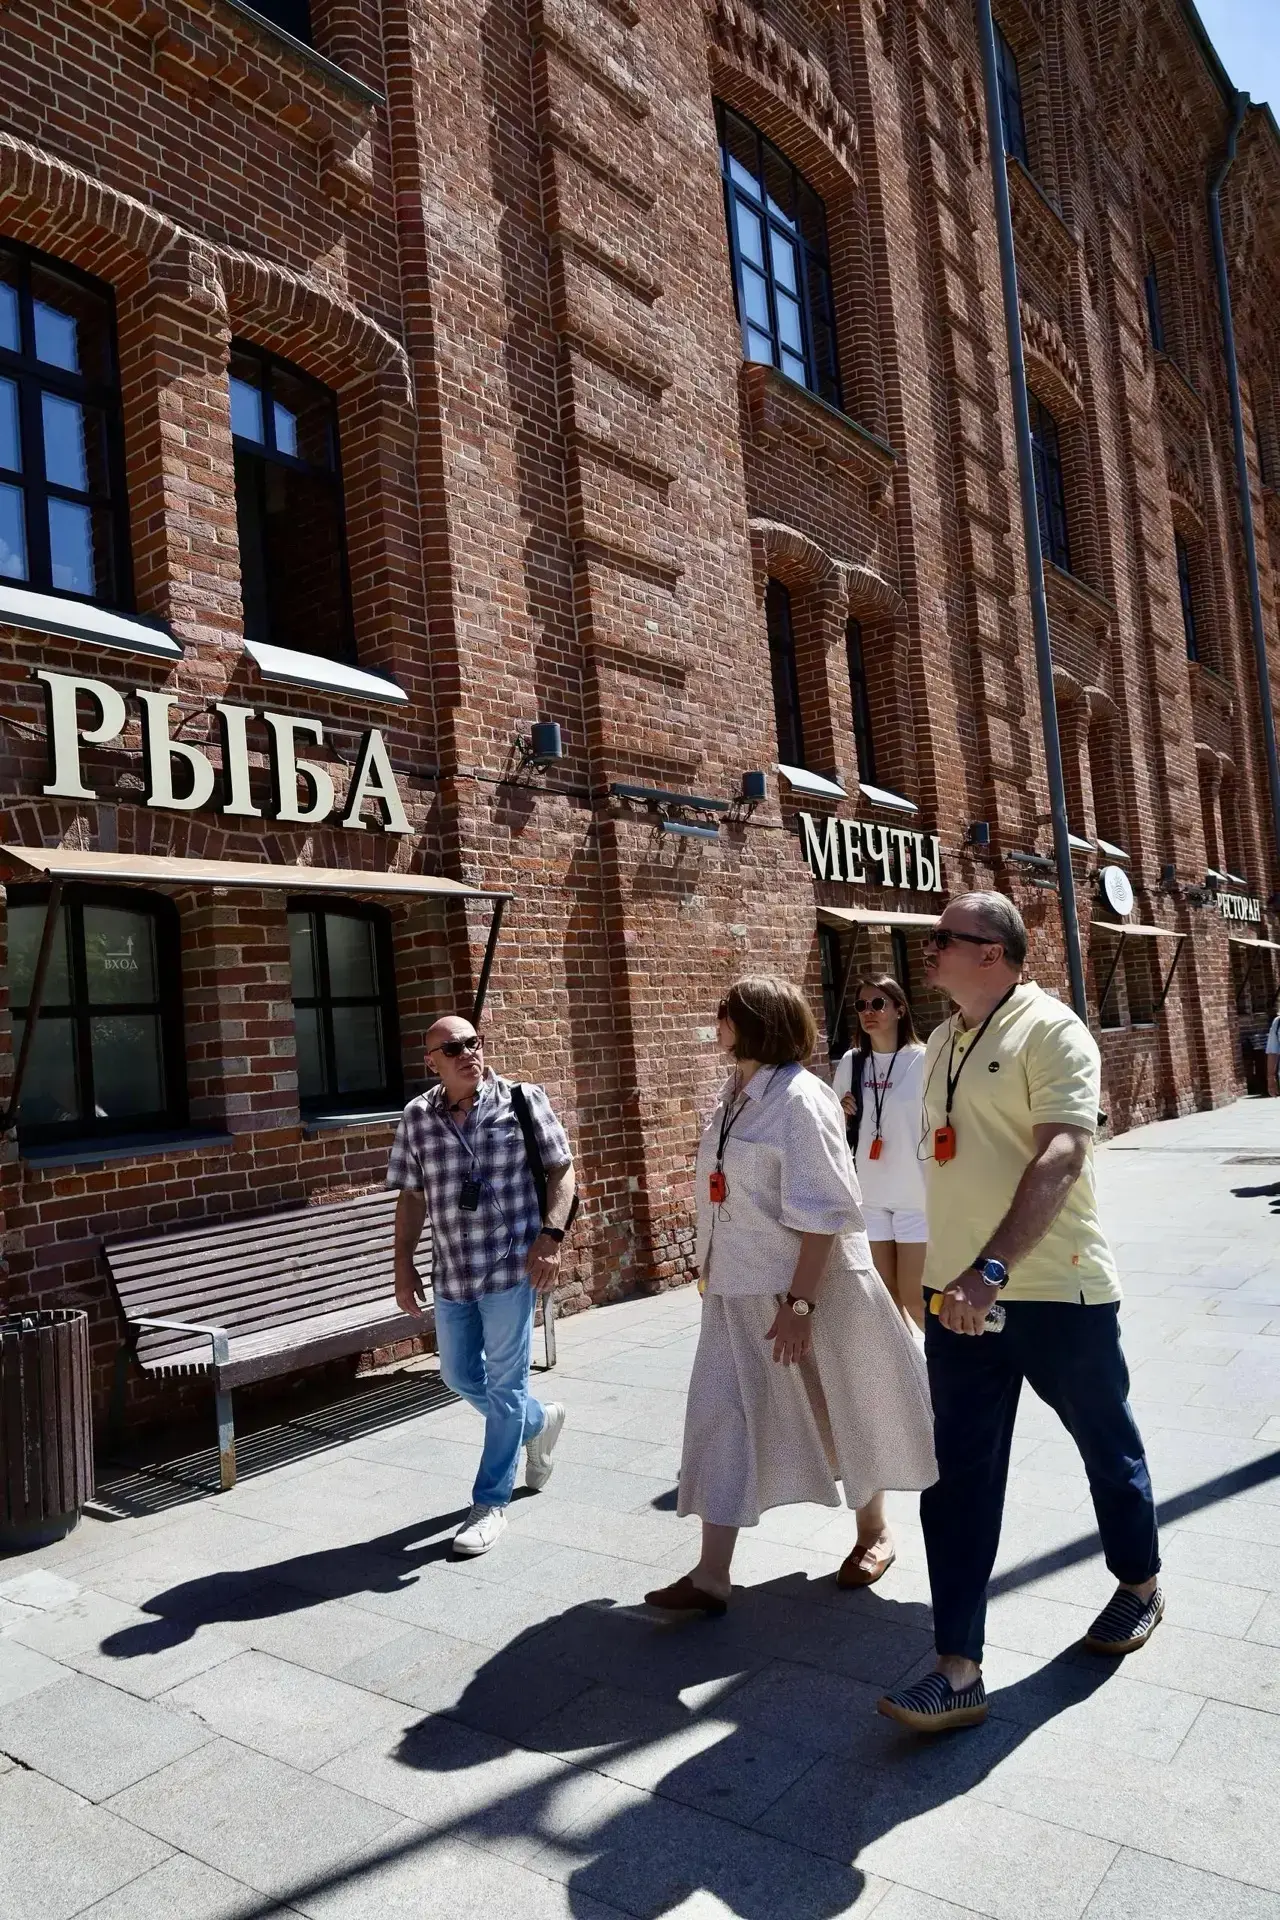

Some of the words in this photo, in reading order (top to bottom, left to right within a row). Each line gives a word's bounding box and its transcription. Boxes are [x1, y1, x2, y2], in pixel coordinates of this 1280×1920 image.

[37, 670, 414, 834] РЫБА
[799, 811, 943, 893] МЕЧТЫ
[1216, 892, 1261, 922] РЕСТОРАН
[104, 959, 139, 970] ВХОД
